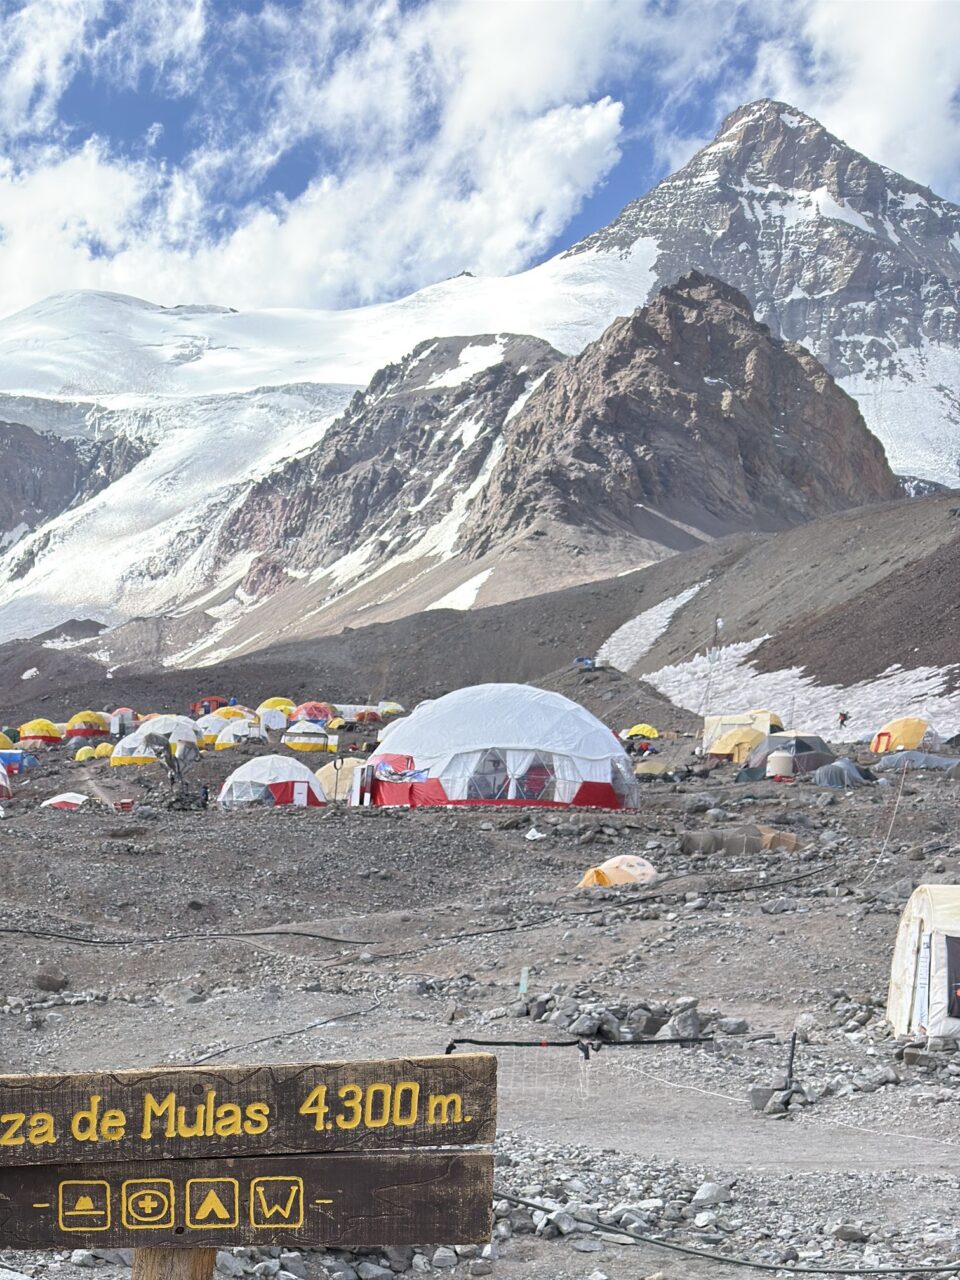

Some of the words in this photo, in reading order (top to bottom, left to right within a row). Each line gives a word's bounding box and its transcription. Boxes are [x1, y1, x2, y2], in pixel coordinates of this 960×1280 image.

[71, 1095, 127, 1141] de
[140, 1090, 270, 1140] Mulas
[298, 1081, 421, 1131] 4.300
[426, 1092, 473, 1125] m.
